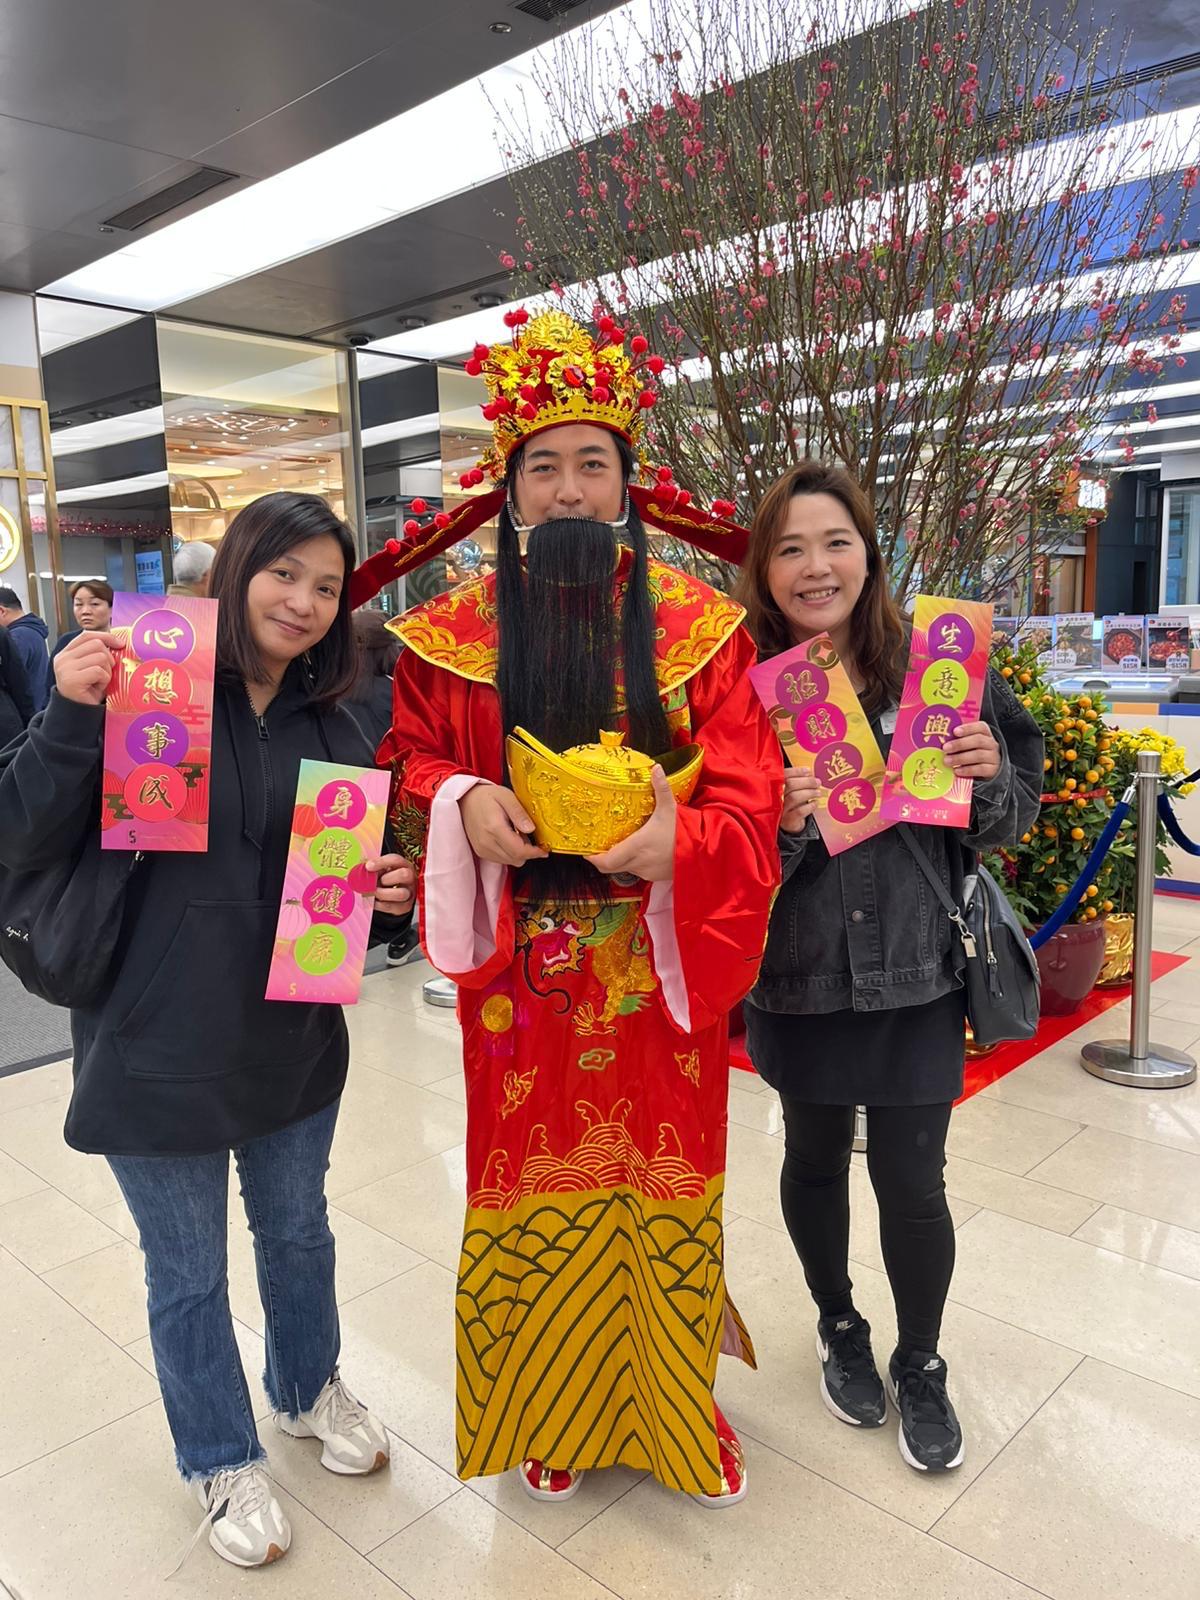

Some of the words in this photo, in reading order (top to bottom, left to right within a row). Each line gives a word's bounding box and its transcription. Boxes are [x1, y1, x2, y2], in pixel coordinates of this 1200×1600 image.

[138, 626, 185, 808] 心想事成
[783, 668, 867, 817] 招財進寶
[911, 622, 963, 790] 生意興隆
[305, 785, 354, 964] 身體健康
